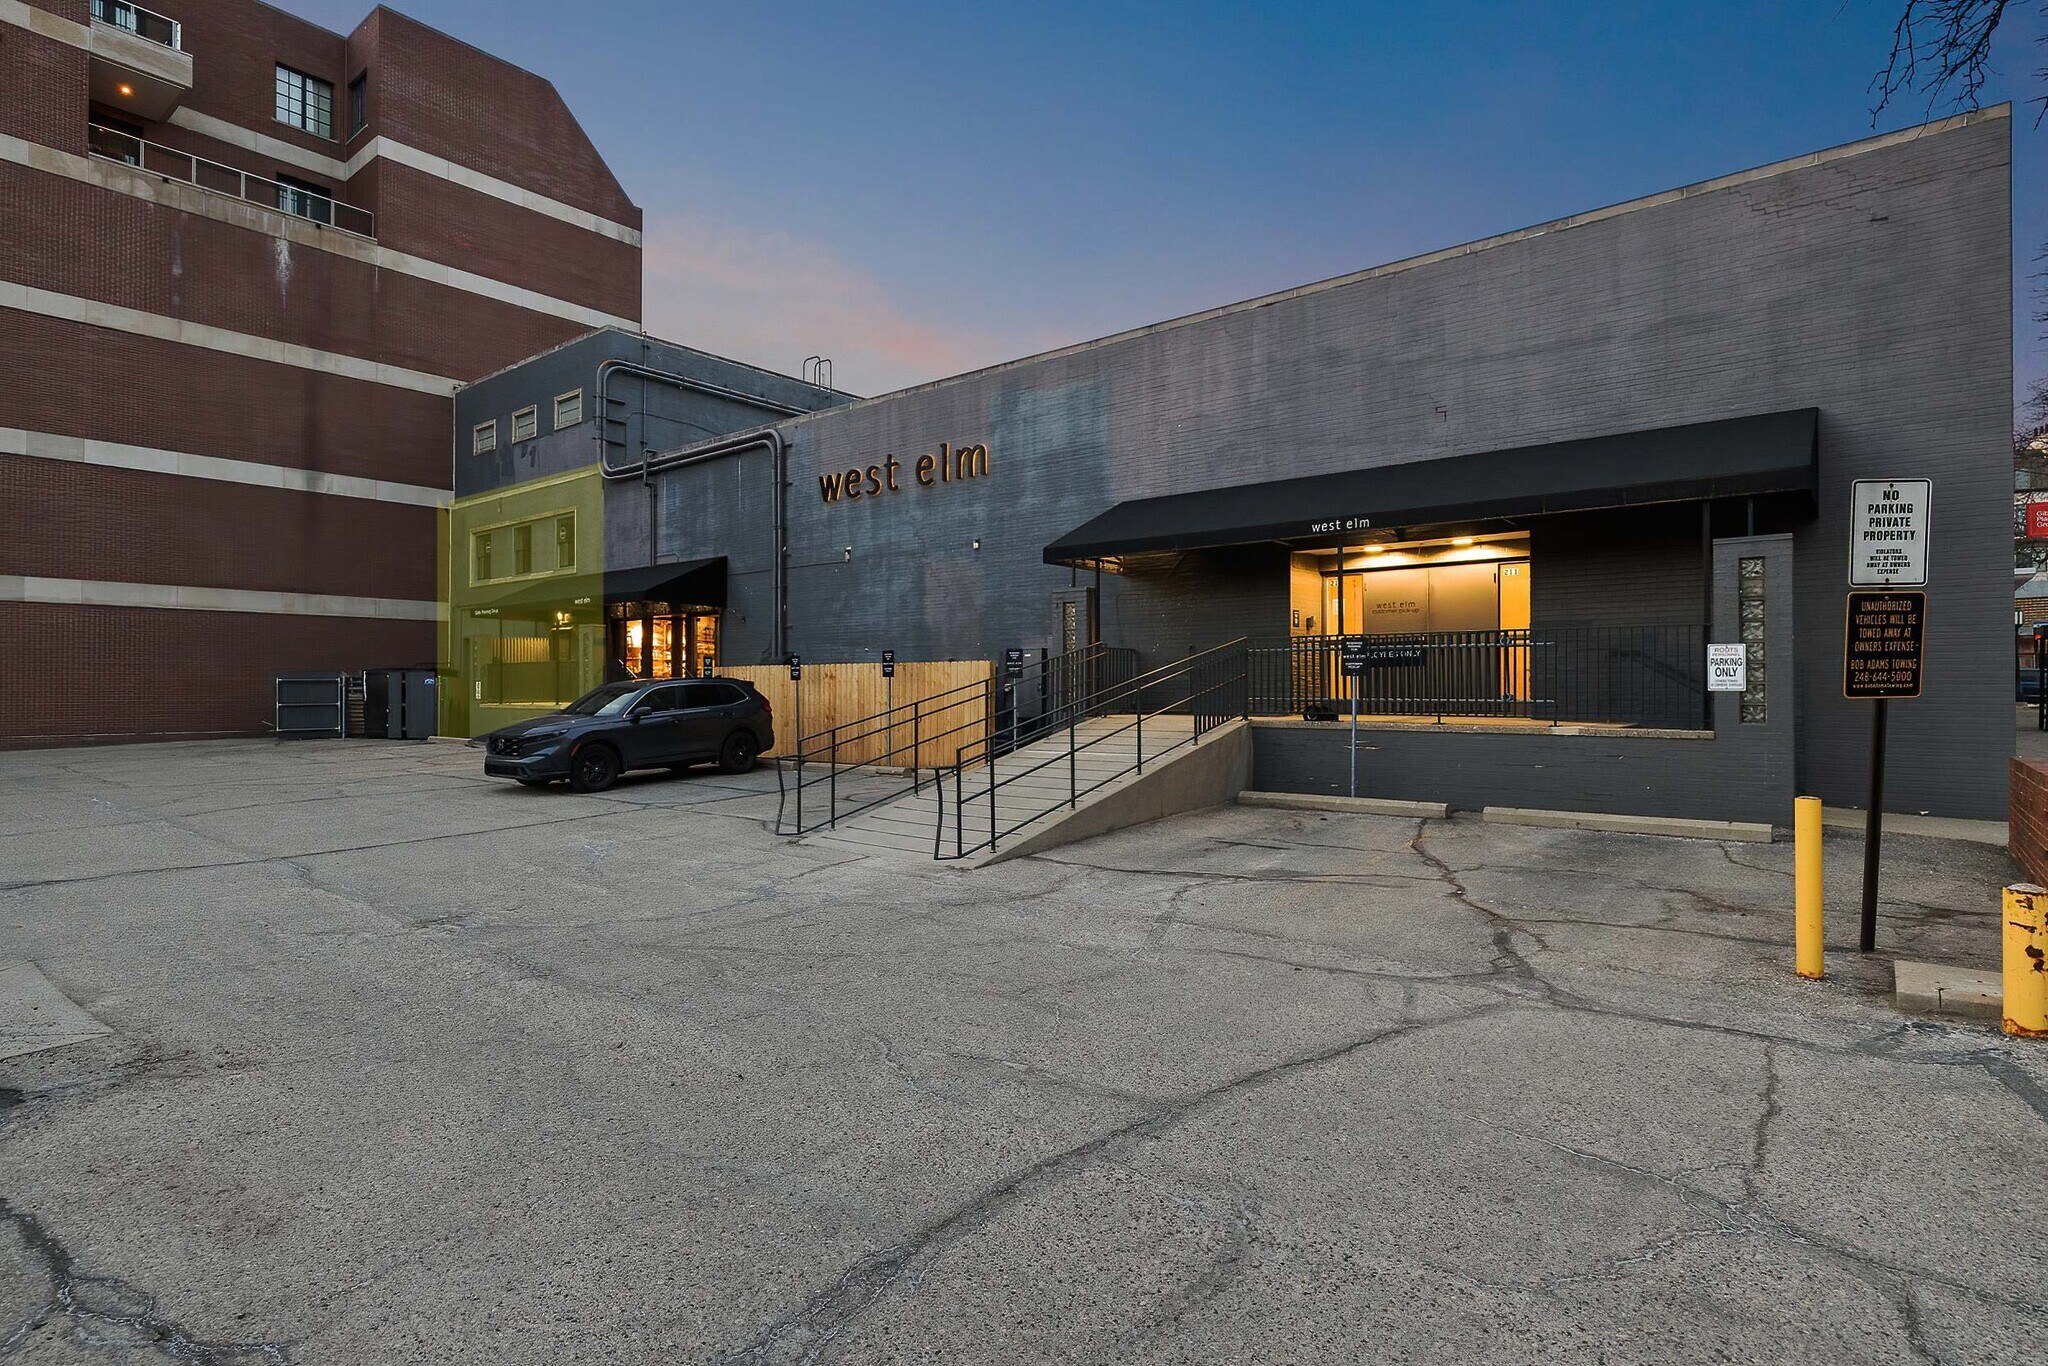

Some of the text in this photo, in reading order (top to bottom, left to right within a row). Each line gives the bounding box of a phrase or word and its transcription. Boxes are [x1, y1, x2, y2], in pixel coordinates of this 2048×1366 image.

[818, 442, 988, 503] west elm
[1883, 490, 1900, 501] NO
[1868, 503, 1914, 514] PARKING
[1311, 518, 1370, 533] west elm
[1869, 517, 1911, 528] PRIVATE
[1863, 530, 1916, 541] PROPERTY
[1376, 601, 1396, 609] west
[1861, 600, 1912, 612] UNAUTHORIZED
[1855, 614, 1917, 625] VEHICLES WILL BE
[1859, 627, 1912, 638] TOWED AWAY AT
[1710, 658, 1742, 666] PARKING
[1850, 658, 1917, 670] BOB ADAMS TOWING
[1715, 667, 1738, 677] ONLY
[1854, 671, 1912, 682] 248-644-5000
